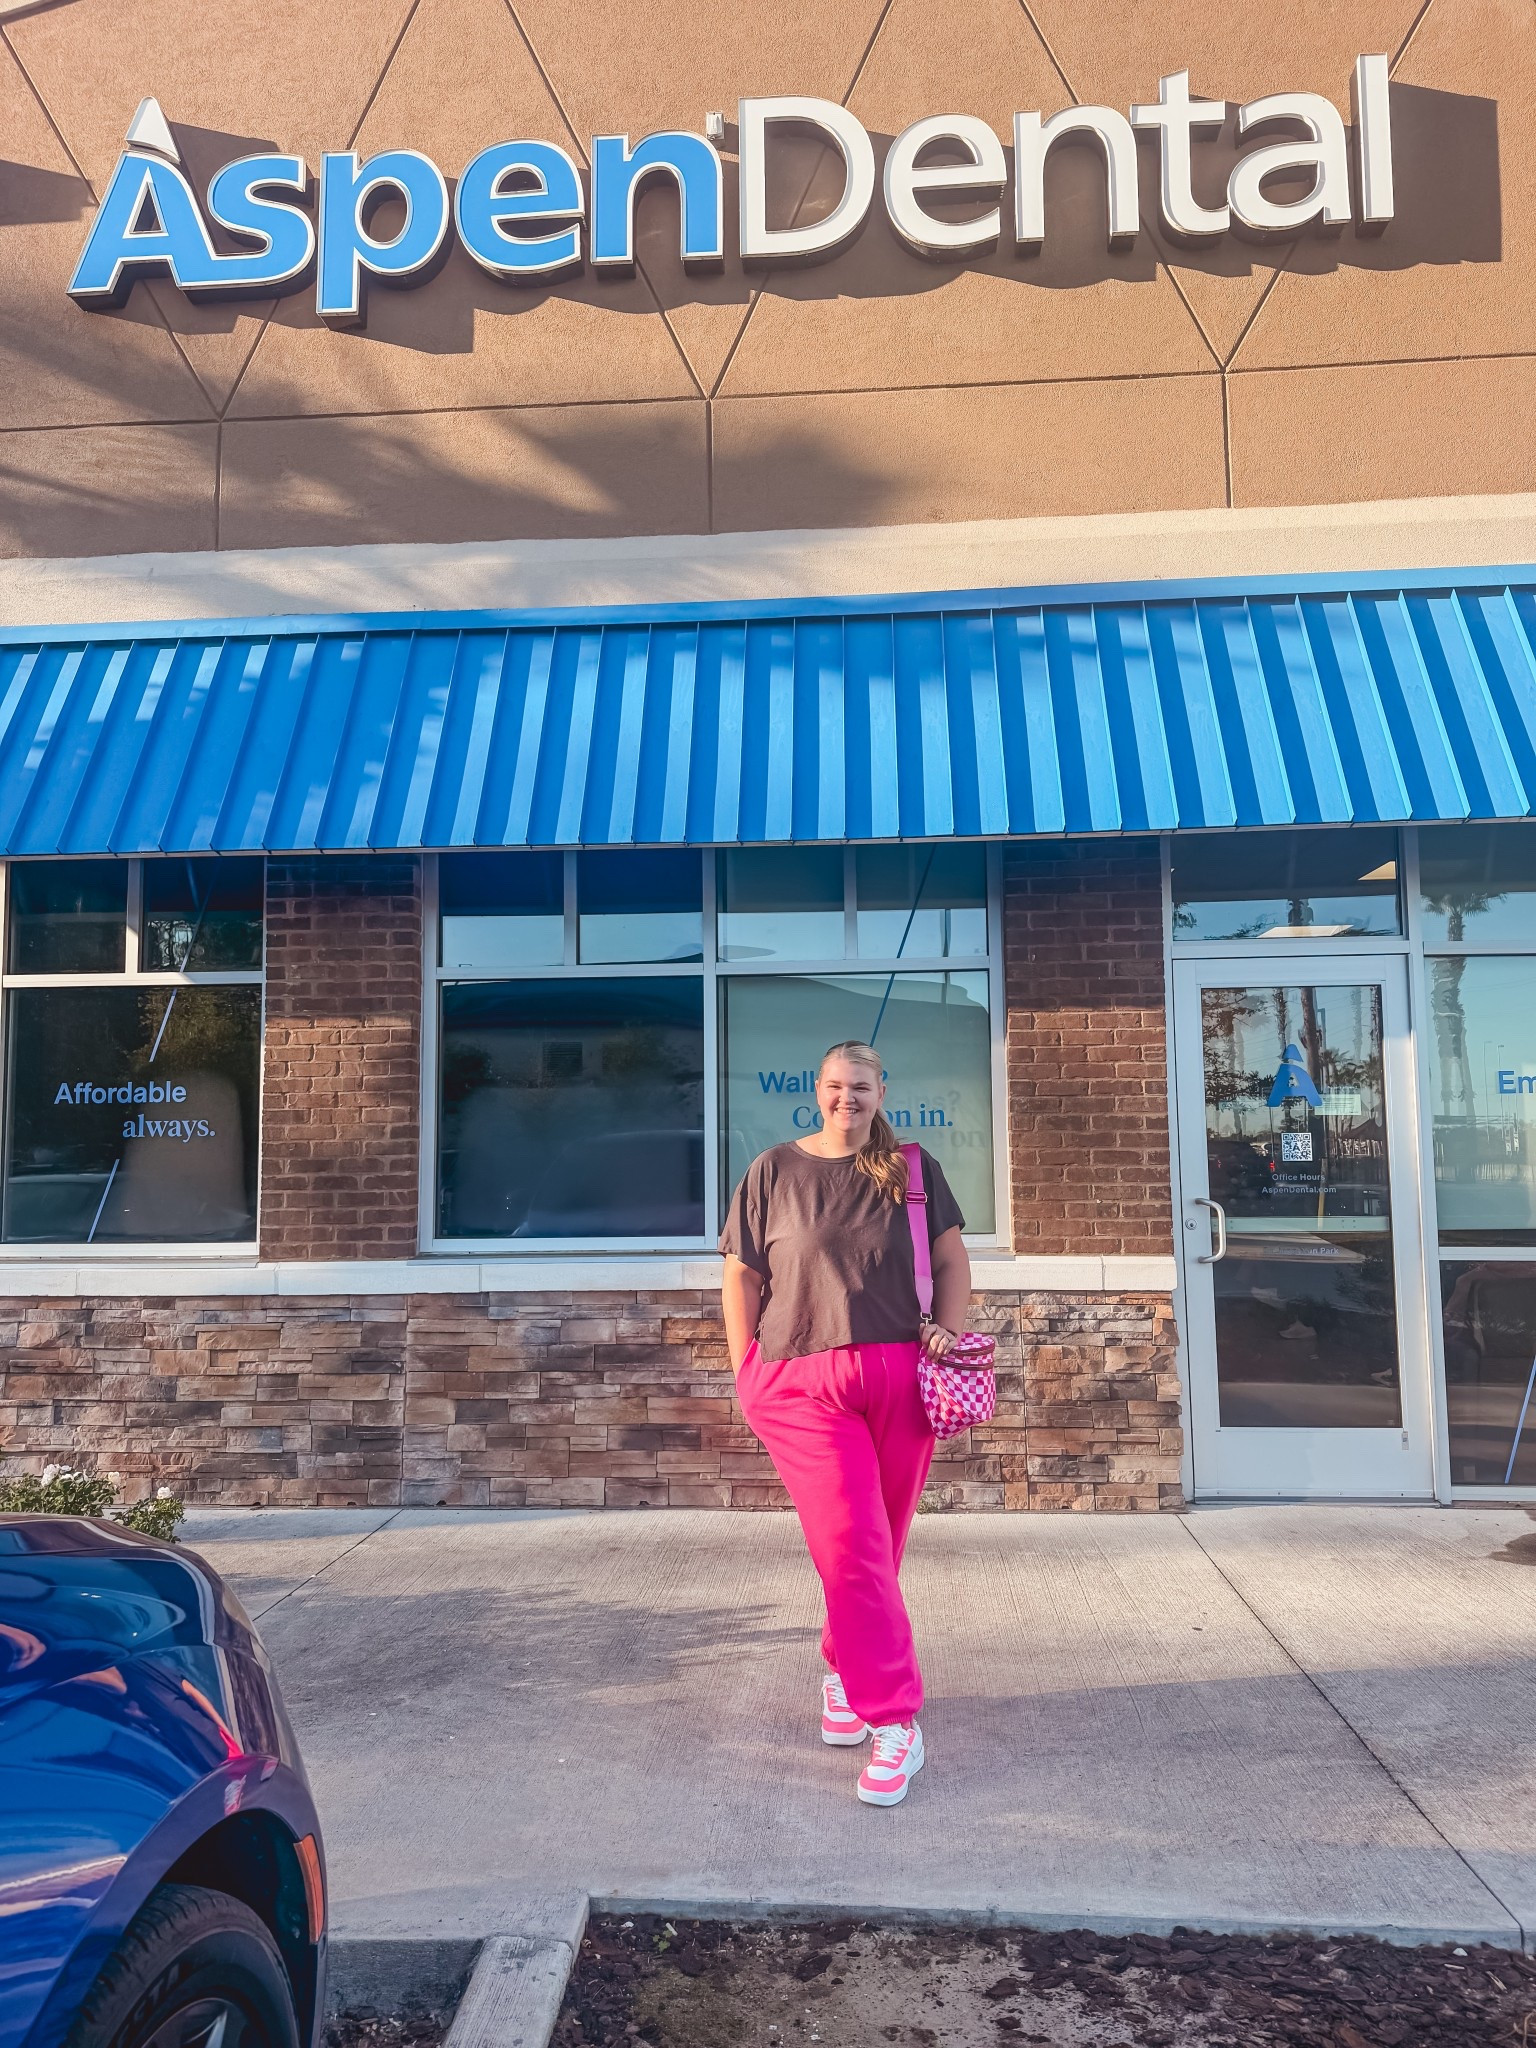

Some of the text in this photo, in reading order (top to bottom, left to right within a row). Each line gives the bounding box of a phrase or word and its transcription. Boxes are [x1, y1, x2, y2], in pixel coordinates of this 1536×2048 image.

[53, 1081, 187, 1104] Affordable
[919, 1103, 953, 1127] in.
[122, 1114, 216, 1143] always.
[1272, 1173, 1326, 1181] Office Hours
[1261, 1186, 1337, 1195] AspenDental.com
[1320, 1247, 1339, 1255] Park
